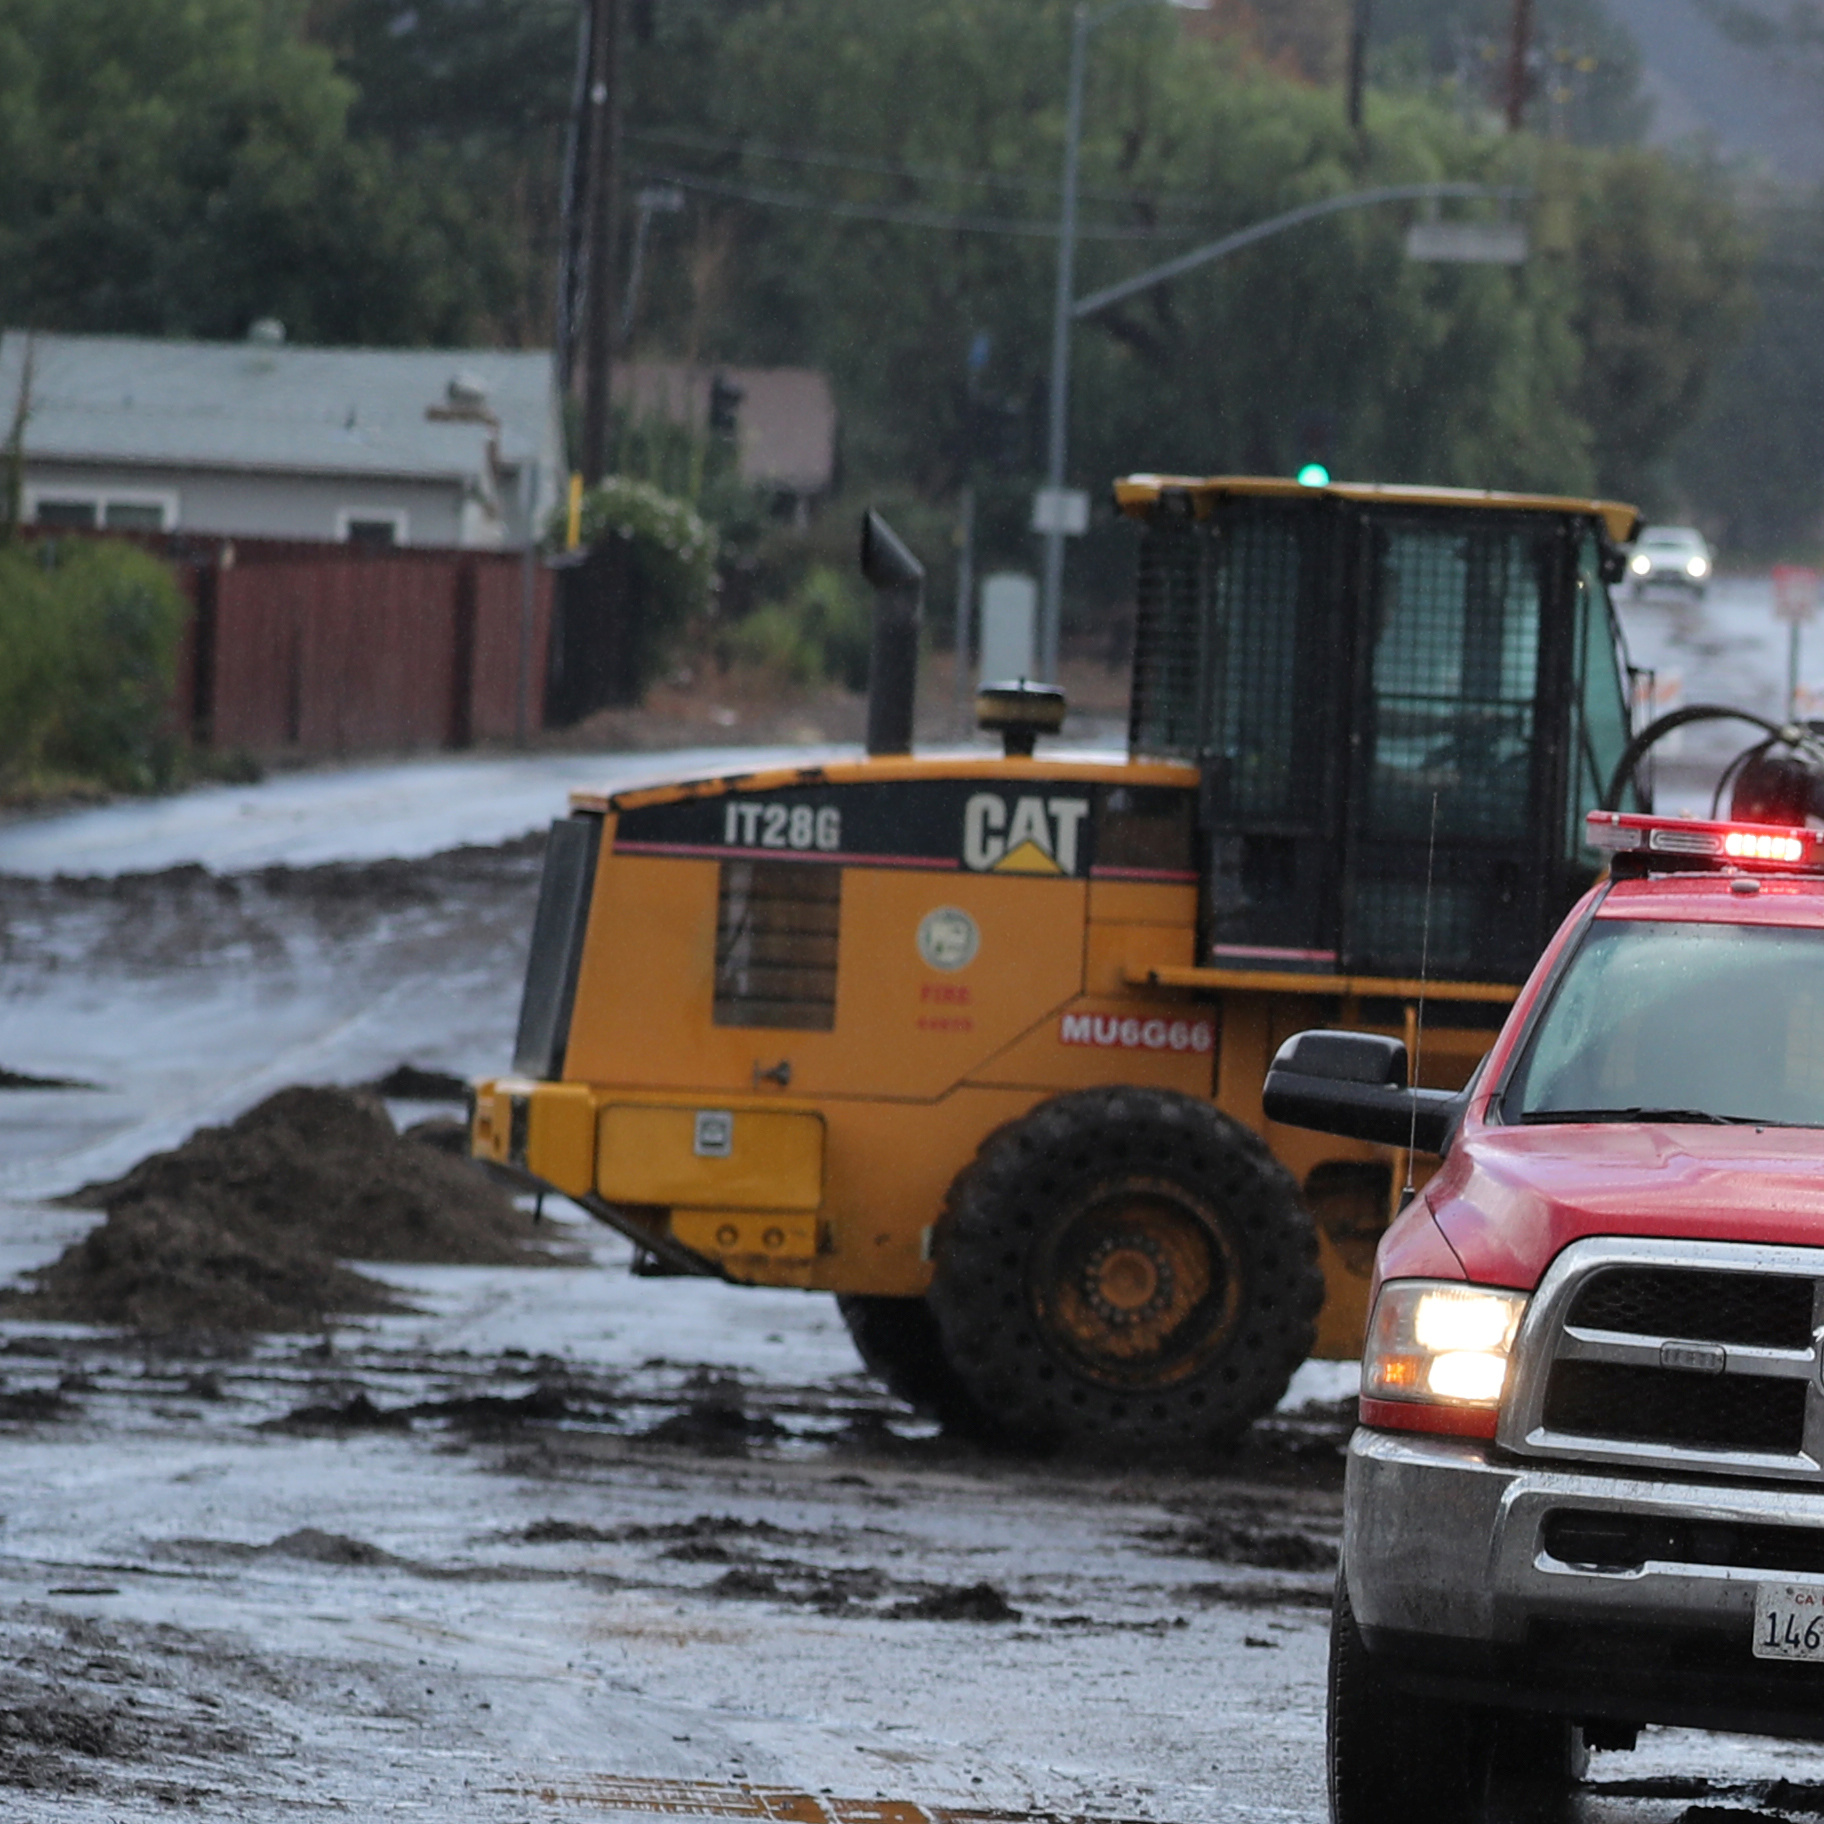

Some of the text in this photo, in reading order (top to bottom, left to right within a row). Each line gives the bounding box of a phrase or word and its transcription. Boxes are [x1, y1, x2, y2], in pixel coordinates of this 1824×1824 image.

[724, 801, 841, 851] IT28G
[963, 792, 1090, 876] CAT
[1795, 1594, 1814, 1606] CA
